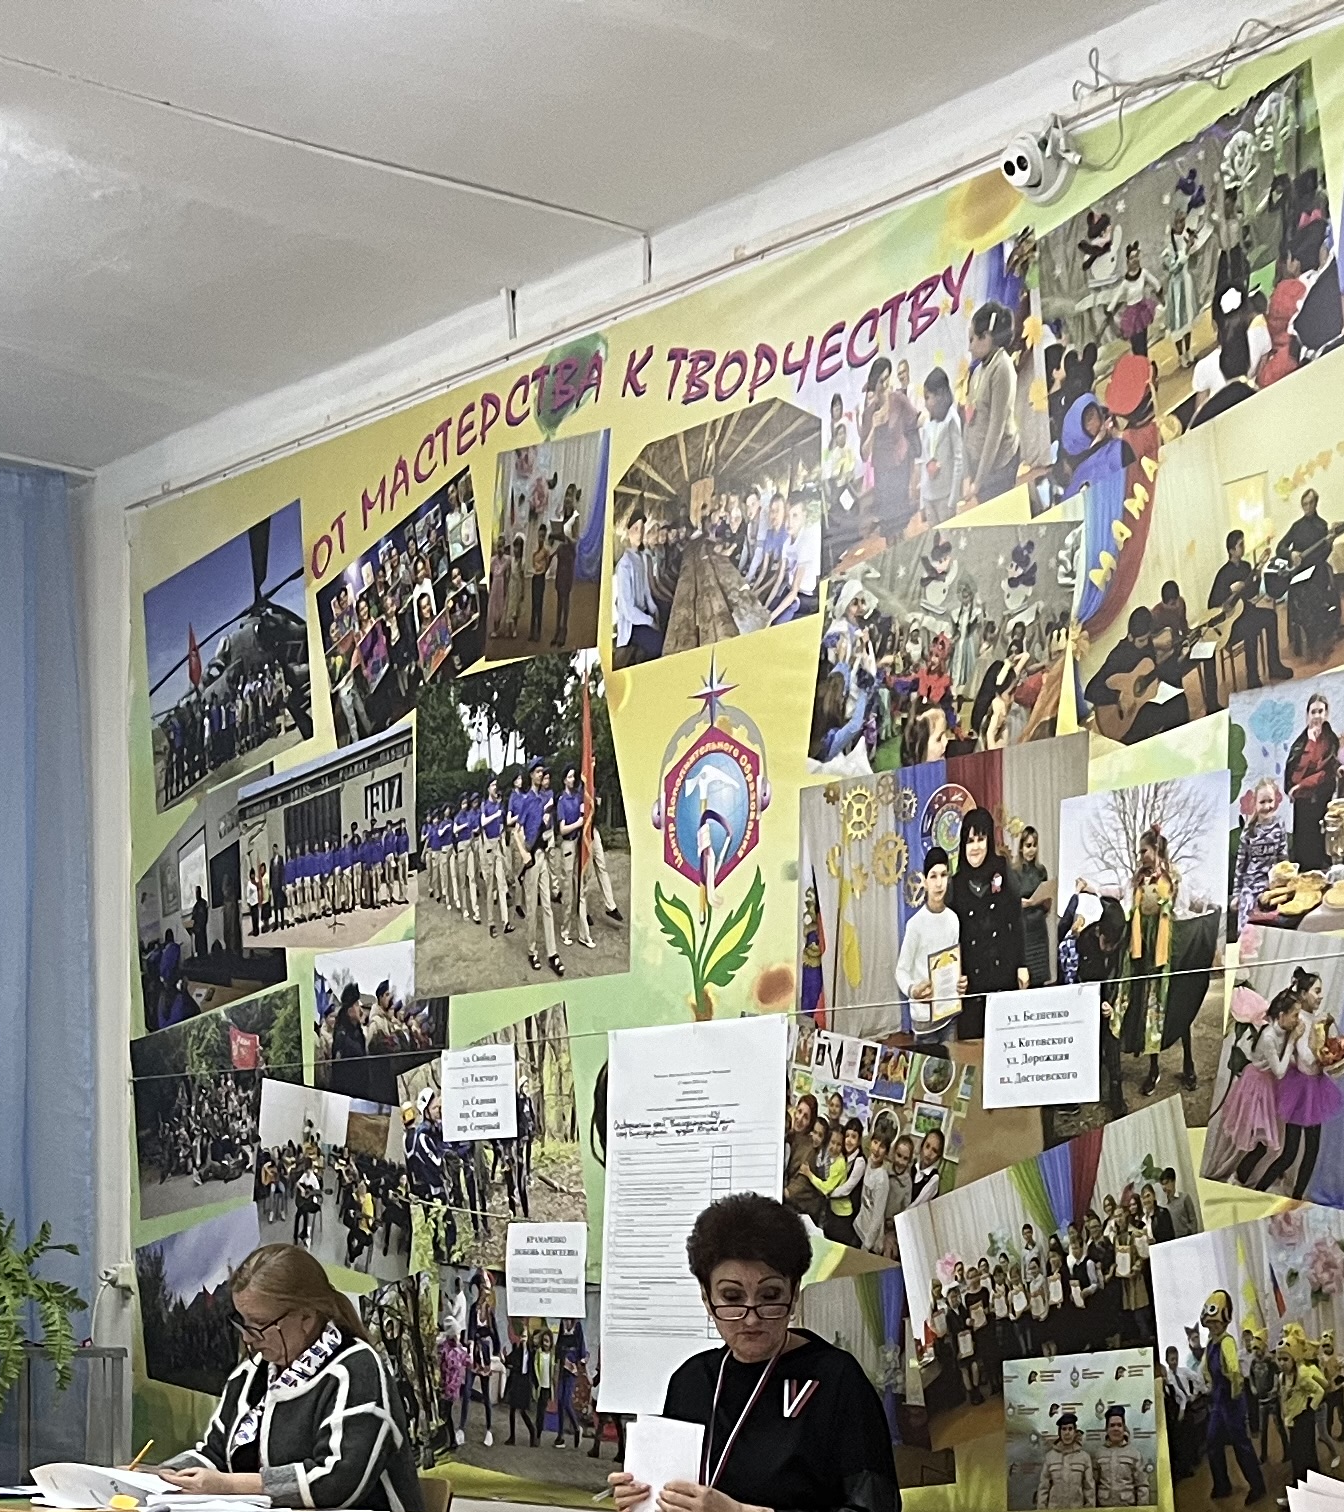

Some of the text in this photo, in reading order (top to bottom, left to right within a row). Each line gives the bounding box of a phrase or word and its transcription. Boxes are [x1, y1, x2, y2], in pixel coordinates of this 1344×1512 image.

[311, 248, 974, 580] ОТ МАСТЕРСТВА К ТВОРЧЕСТВУ
[1018, 1036, 1074, 1048] Котовского
[1021, 1053, 1070, 1066] Дорожная
[1014, 1071, 1078, 1084] Достоевского
